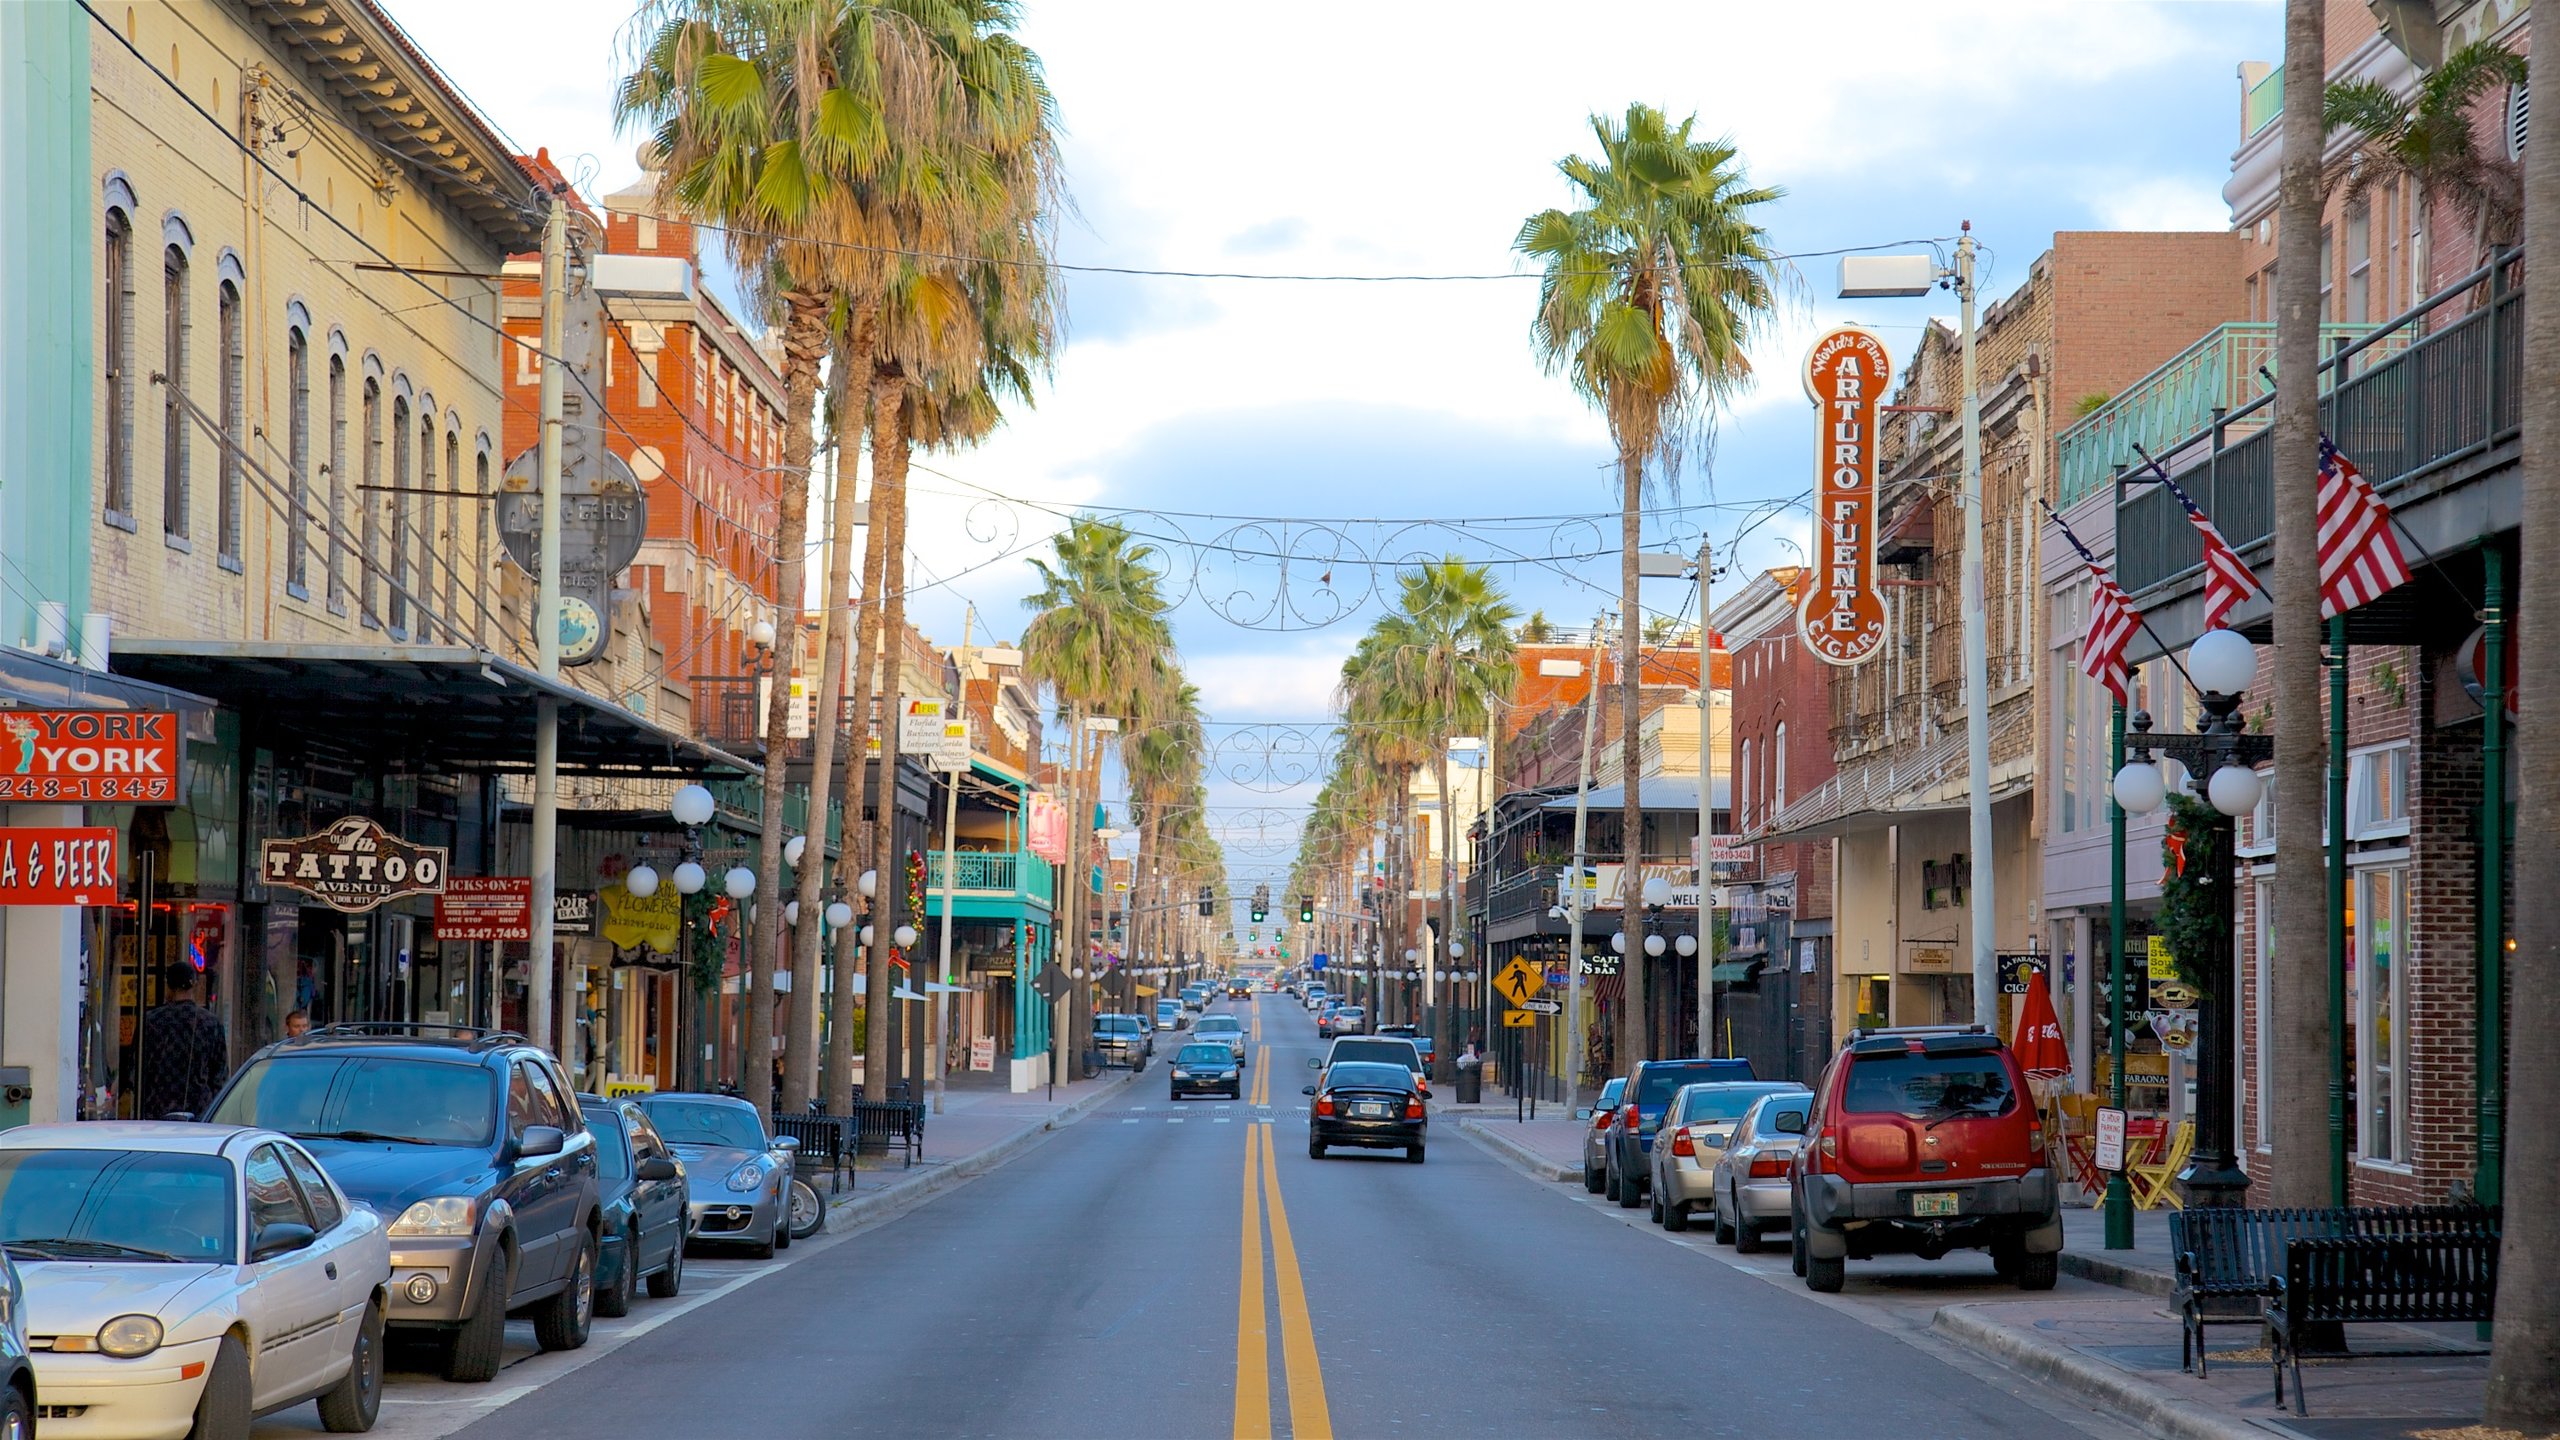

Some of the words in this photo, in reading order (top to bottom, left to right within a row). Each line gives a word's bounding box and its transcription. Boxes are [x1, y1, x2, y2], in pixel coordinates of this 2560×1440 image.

[1812, 334, 1854, 376] World's
[1856, 336, 1888, 379] Finest
[1833, 356, 1860, 489] ARTURO
[1832, 500, 1859, 632] FUENTE
[1808, 620, 1883, 658] CIGARS
[39, 713, 165, 741] YORK
[38, 747, 163, 773] YORK
[0, 777, 168, 799] 248-1845
[337, 820, 377, 852] 7th
[1711, 850, 1751, 860] 13-610-3428
[28, 841, 44, 887] &
[54, 839, 113, 889] BEER
[269, 852, 438, 884] TATTOO
[314, 880, 392, 895] AVENUE
[446, 880, 483, 891] ICKS
[333, 896, 351, 904] YBOR
[353, 897, 371, 905] CITY
[616, 894, 682, 916] FLOWERS
[560, 908, 585, 918] BAR
[438, 927, 528, 939] 813.247.7463
[1592, 955, 1620, 963] CAFE
[2001, 960, 2012, 970] LA
[2012, 955, 2047, 970] FARAONA
[2150, 958, 2171, 966] Sou
[2150, 967, 2178, 977] Comp
[1524, 1001, 1538, 1009] ONE
[1538, 1001, 1551, 1009] WAY
[2125, 1074, 2164, 1084] FARAONA
[2101, 1113, 2106, 1121] 2
[2101, 1123, 2121, 1133] PARKING
[2104, 1134, 2116, 1142] ONLY
